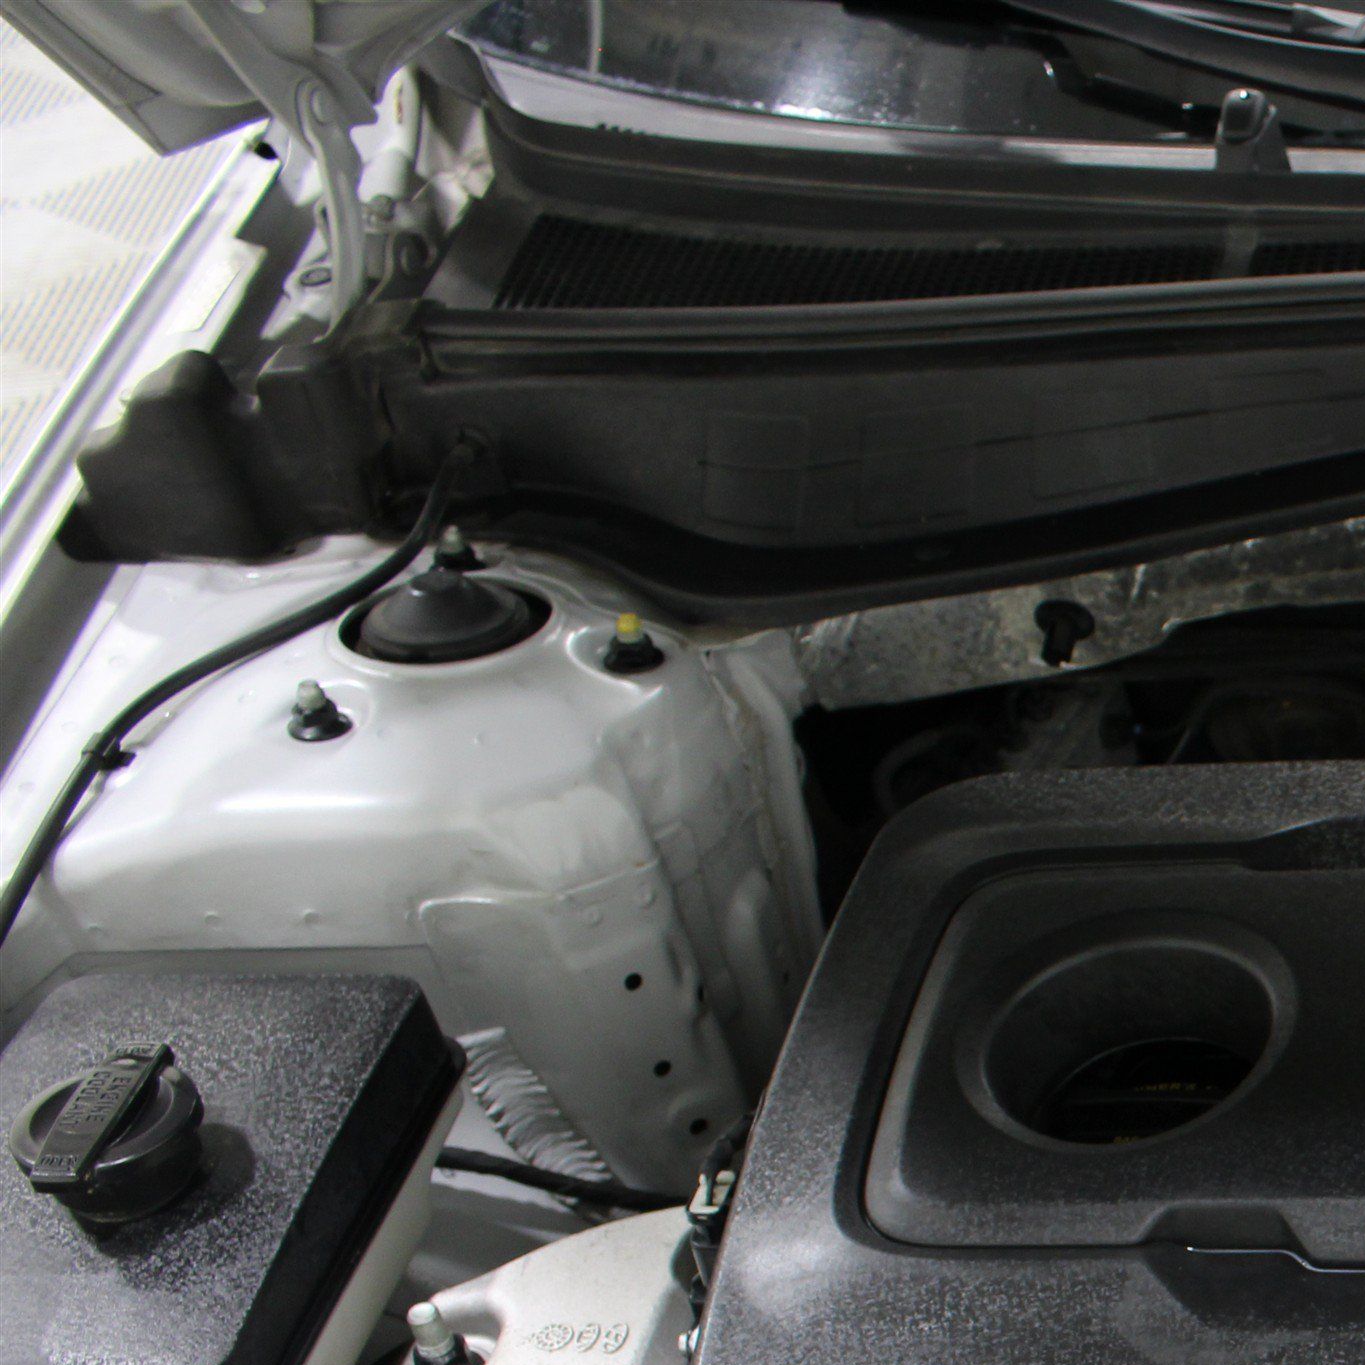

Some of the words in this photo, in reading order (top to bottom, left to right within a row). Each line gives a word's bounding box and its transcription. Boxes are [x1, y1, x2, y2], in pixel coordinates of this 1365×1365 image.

[60, 1071, 110, 1126] COOLANT
[85, 1076, 132, 1123] ENGINE
[40, 1154, 81, 1168] OPEN
